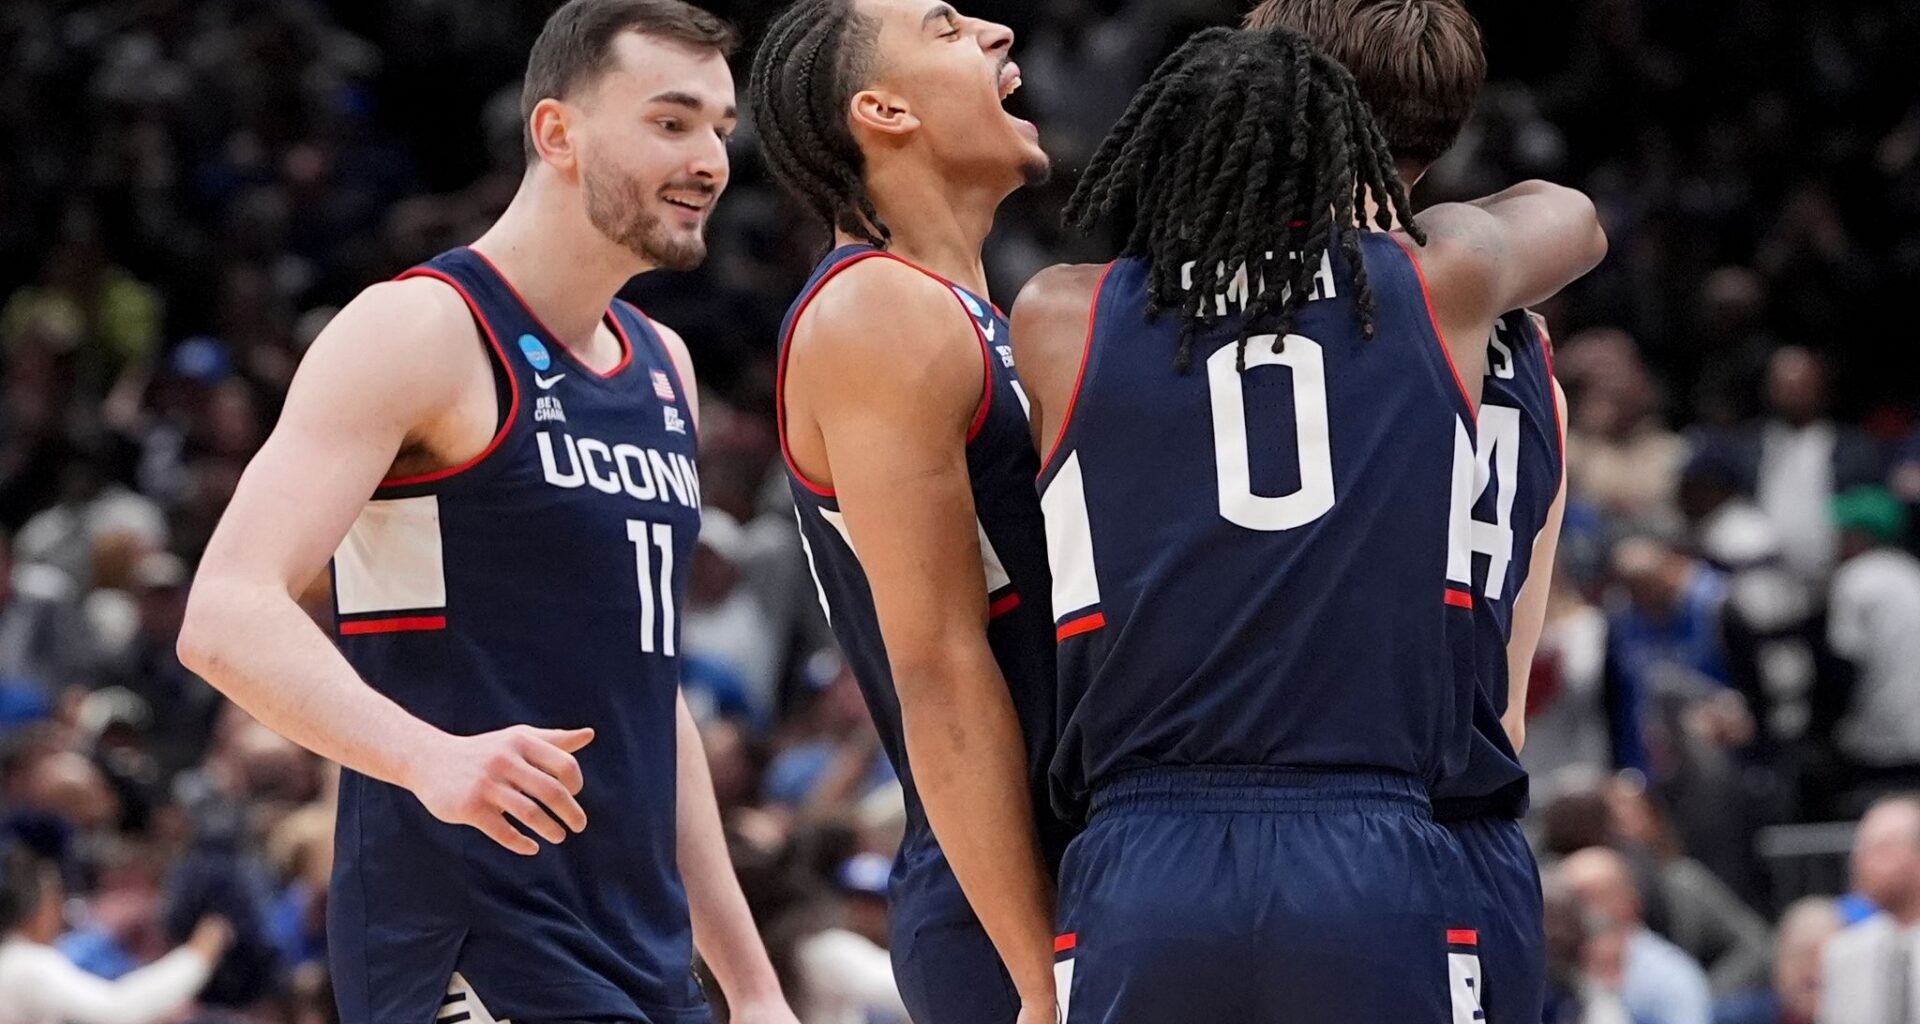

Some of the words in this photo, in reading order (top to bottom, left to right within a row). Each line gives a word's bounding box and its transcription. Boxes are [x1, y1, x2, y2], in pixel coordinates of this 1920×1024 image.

[536, 396, 553, 409] BE
[1206, 333, 1336, 532] 0
[536, 431, 701, 510] UCONN
[626, 518, 676, 657] 11
